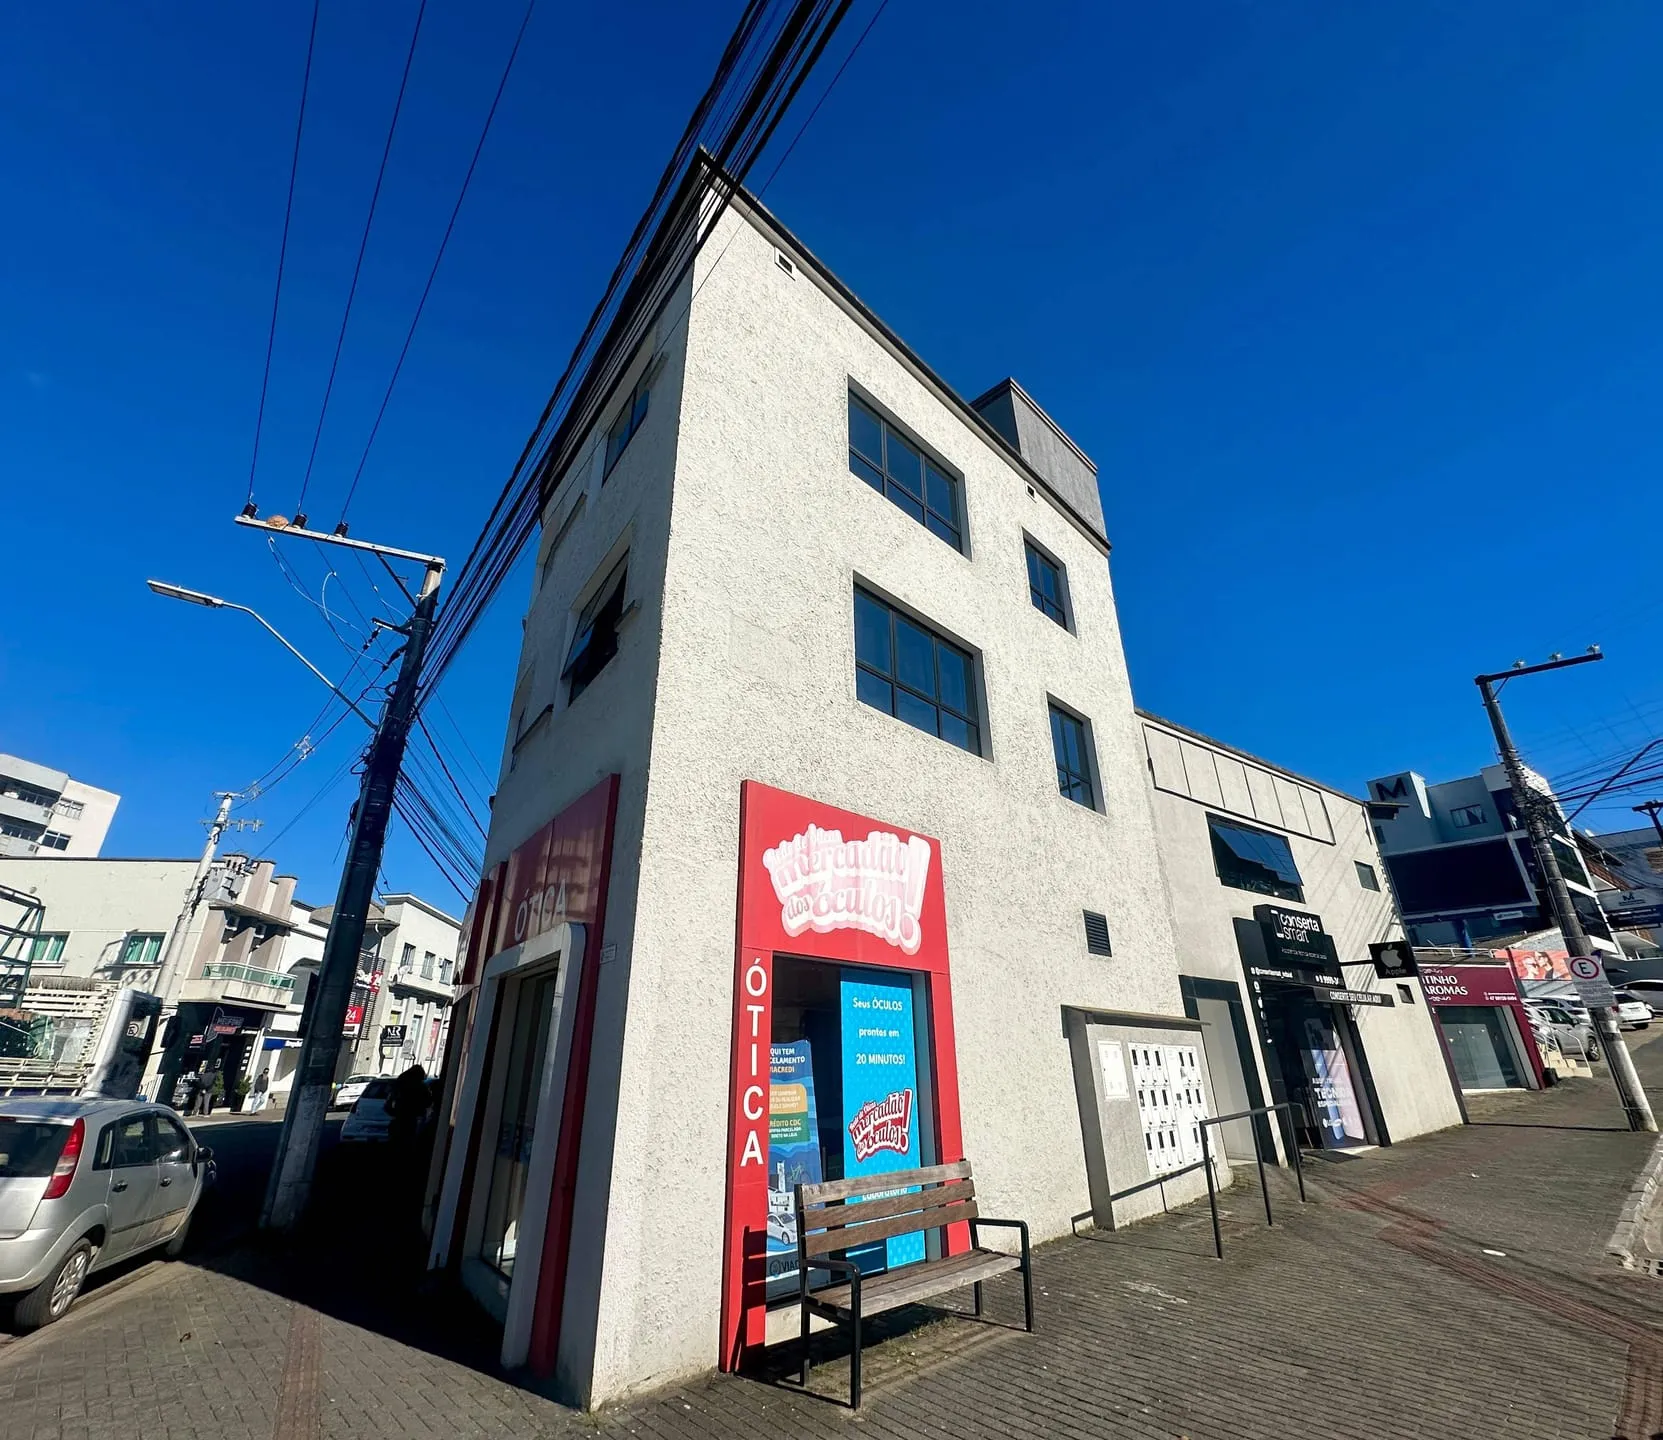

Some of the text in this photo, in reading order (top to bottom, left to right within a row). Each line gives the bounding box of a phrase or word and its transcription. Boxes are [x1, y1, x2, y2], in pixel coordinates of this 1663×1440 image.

[1376, 777, 1408, 802] M
[515, 879, 567, 942] ÓTICA
[1280, 914, 1320, 932] conserta
[1284, 927, 1309, 943] smart
[1385, 967, 1407, 976] Apple
[1578, 962, 1591, 975] E
[853, 996, 903, 1011] Seus ÓCULOS
[740, 957, 767, 1167] ÓTICA
[856, 1053, 906, 1065] 20 MINUTOS!
